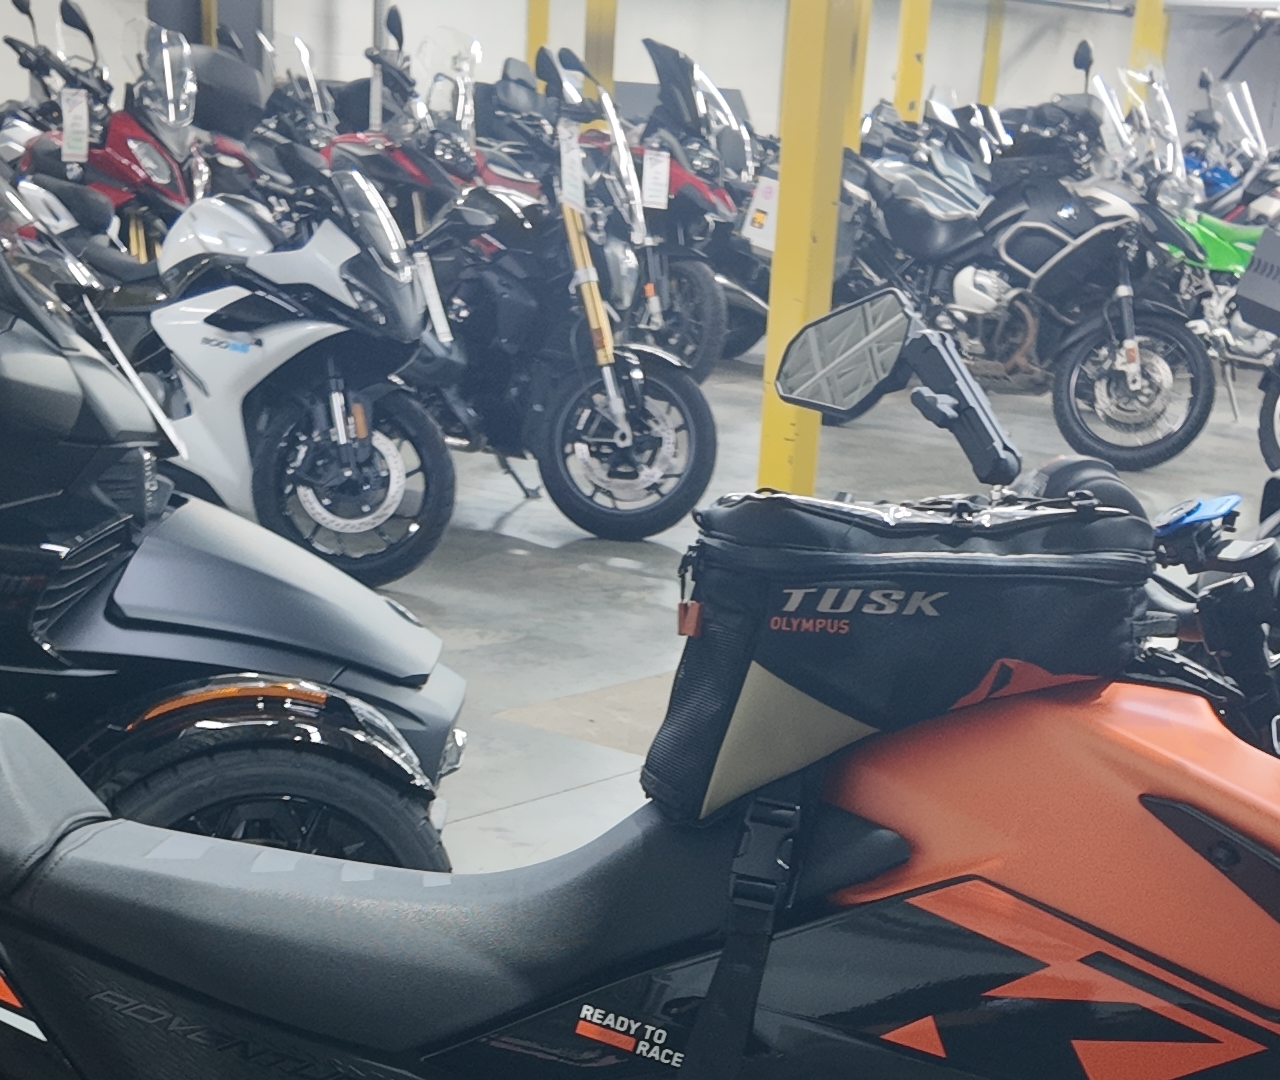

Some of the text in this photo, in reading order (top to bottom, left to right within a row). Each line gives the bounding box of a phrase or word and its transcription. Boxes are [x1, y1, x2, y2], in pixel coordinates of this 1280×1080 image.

[782, 588, 949, 616] TUSK
[770, 616, 850, 634] OLYMPUS
[580, 1004, 668, 1045] READY TO
[636, 1040, 685, 1068] RACE
